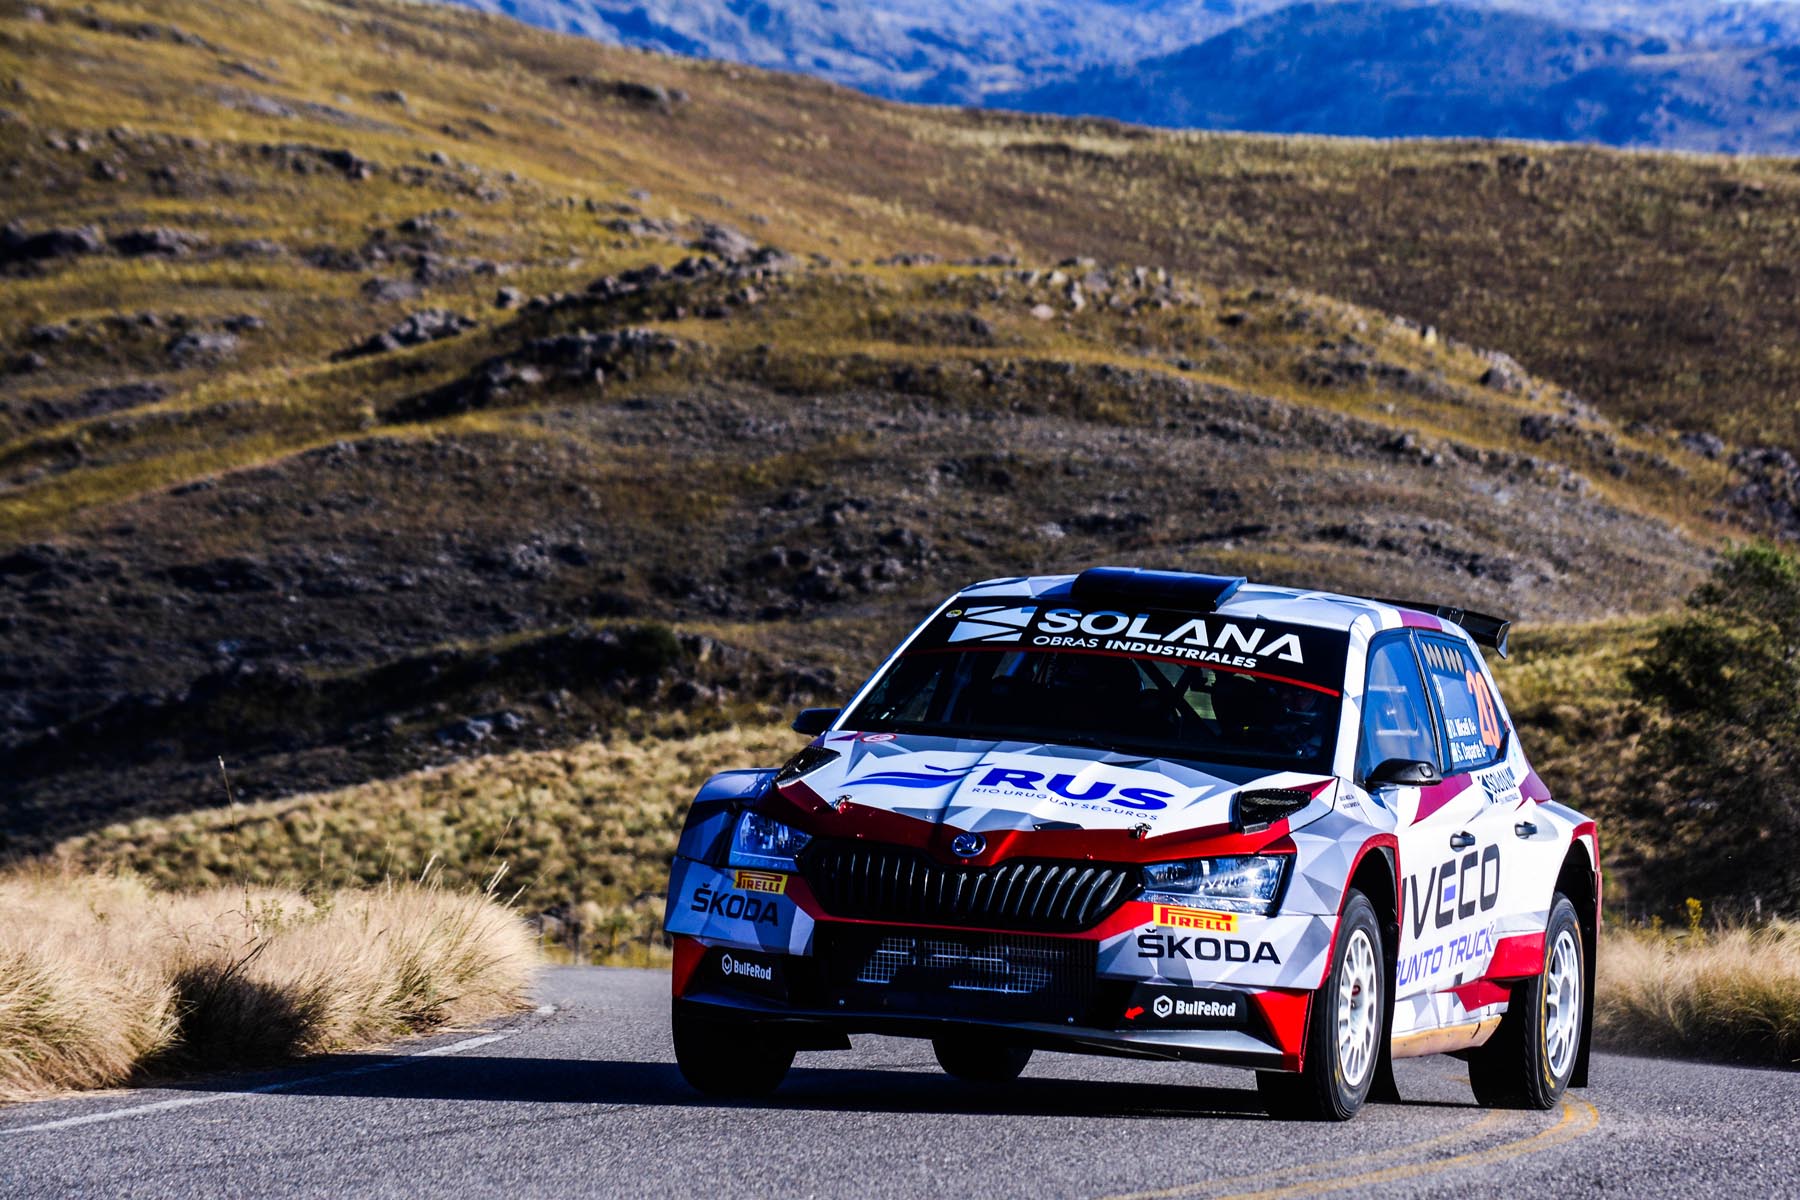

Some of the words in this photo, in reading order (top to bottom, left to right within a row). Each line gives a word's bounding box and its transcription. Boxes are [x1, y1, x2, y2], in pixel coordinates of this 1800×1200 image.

[1033, 635, 1099, 648] OBRAS
[1105, 639, 1257, 668] INDUSTRIALES
[1037, 608, 1304, 664] SOLANA
[1466, 669, 1501, 750] 20
[977, 767, 1176, 811] RUS
[1081, 802, 1159, 821] SEGUROS
[735, 871, 783, 893] PIRELLI
[1400, 843, 1500, 942] IVECO
[691, 883, 779, 927] ŠKODA
[1160, 906, 1233, 932] PIRELLI
[1137, 929, 1282, 965] ŠKODA
[1449, 924, 1494, 968] TRUCK
[734, 960, 772, 980] BulFeRod
[1175, 1000, 1237, 1017] BulFeRod
